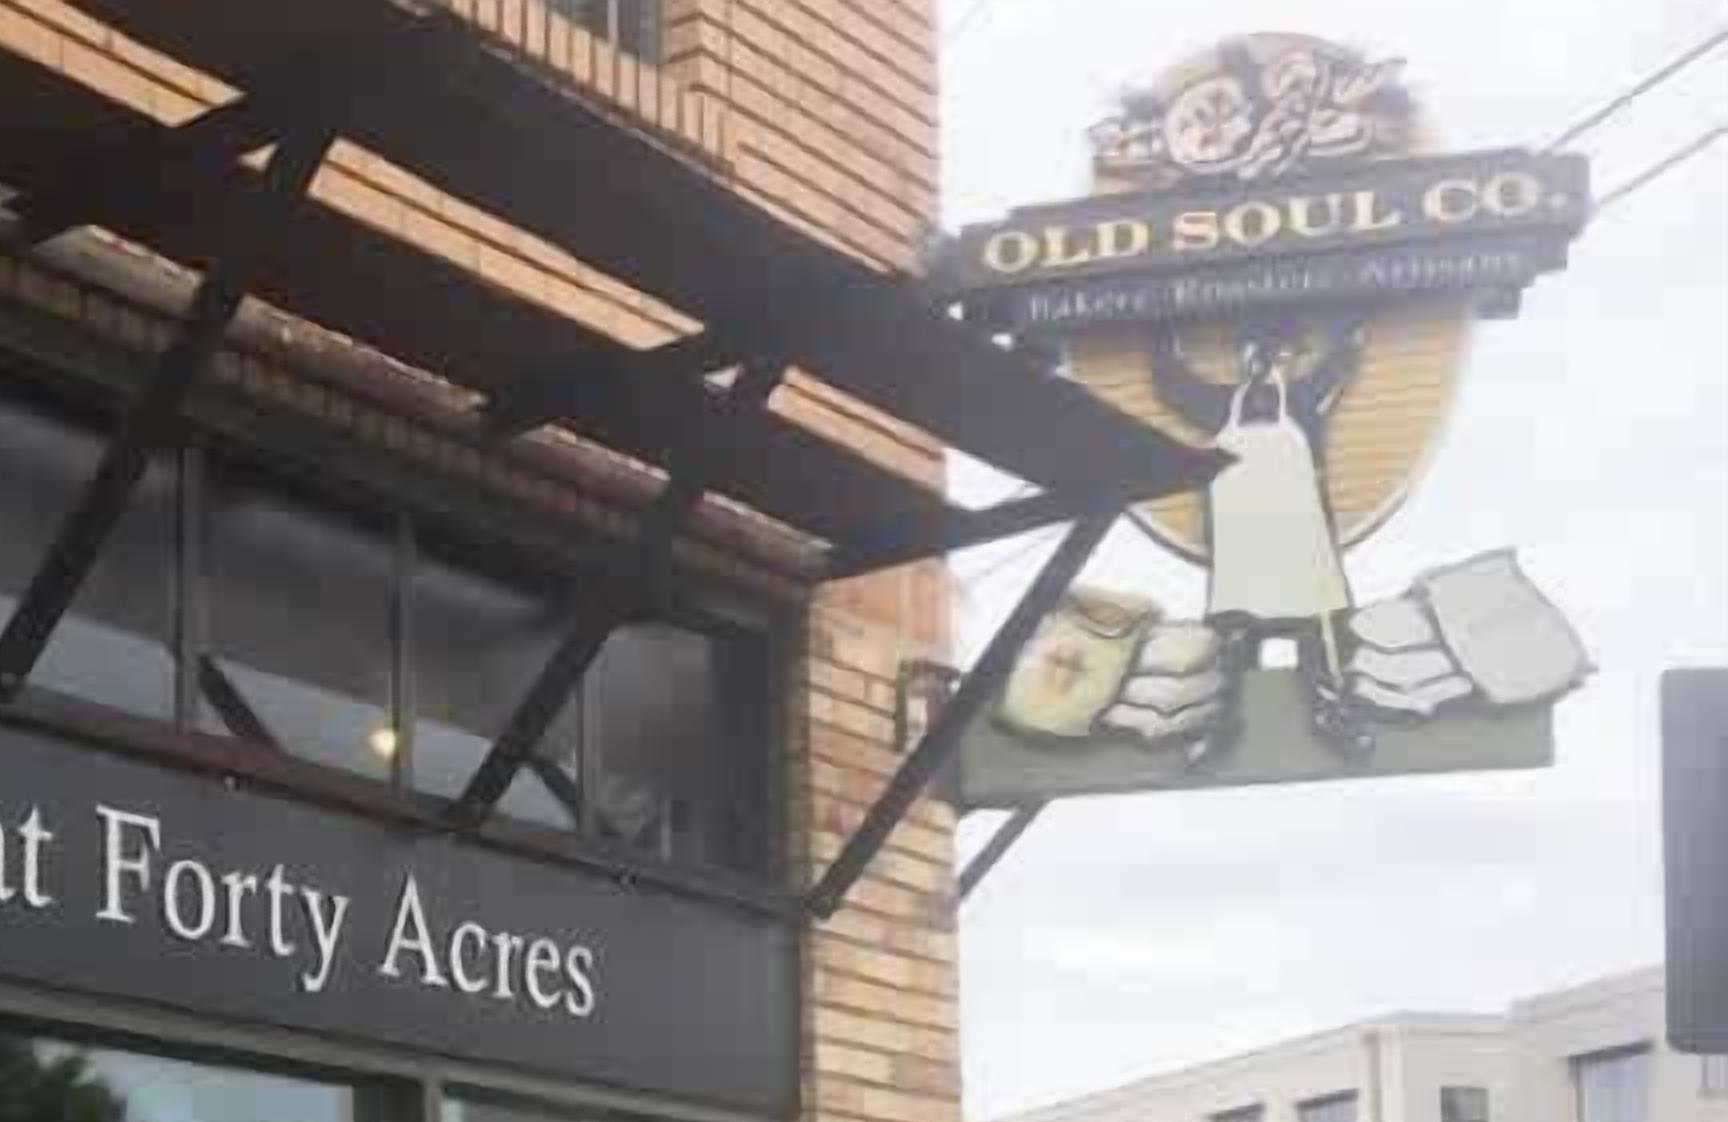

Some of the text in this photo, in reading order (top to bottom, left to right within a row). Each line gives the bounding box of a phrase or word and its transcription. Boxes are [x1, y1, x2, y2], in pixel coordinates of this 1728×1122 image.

[983, 172, 1569, 273] OLD SOUL CO.
[94, 803, 348, 992] Forty
[379, 872, 596, 1017] Acres
